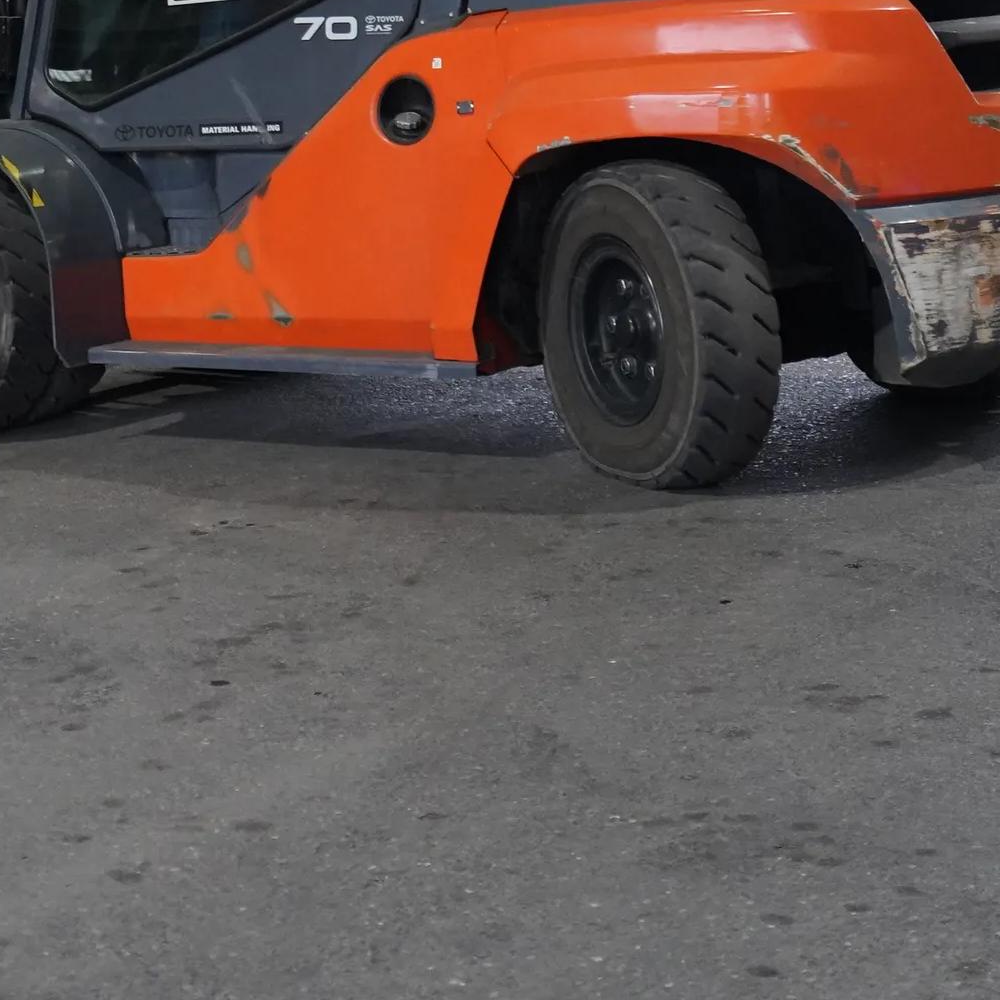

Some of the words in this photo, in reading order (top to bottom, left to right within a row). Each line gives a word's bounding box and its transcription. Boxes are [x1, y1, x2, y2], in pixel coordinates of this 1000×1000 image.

[293, 16, 358, 41] 70
[376, 15, 405, 23] TOYOTA
[365, 24, 393, 32] SAS
[138, 124, 195, 139] TOYOTA
[201, 125, 240, 135] MATERIAL
